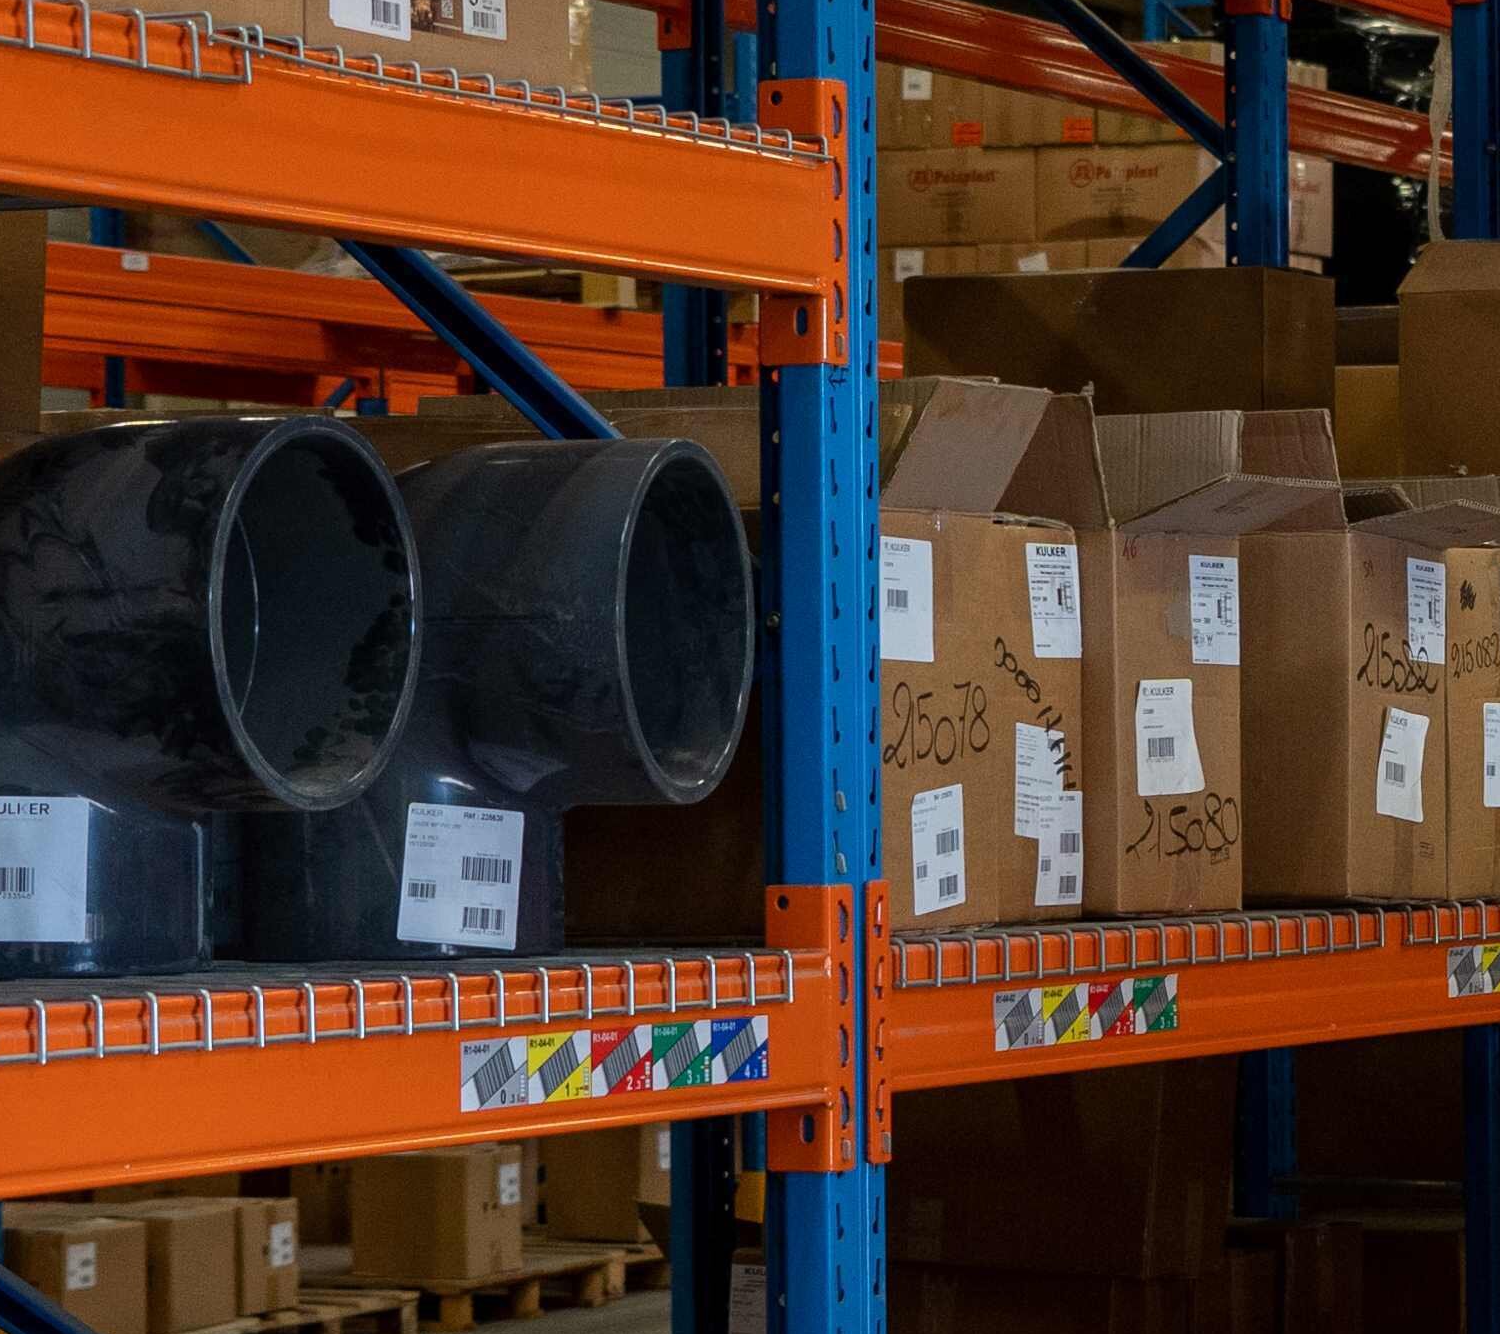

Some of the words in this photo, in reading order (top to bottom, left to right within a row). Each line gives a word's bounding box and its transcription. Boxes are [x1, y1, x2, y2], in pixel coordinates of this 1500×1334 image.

[1036, 546, 1067, 557] KULKER
[883, 681, 991, 769] 215078
[1125, 792, 1240, 861] 215080
[653, 1025, 678, 1036] R1-04-01
[712, 1022, 737, 1033] R1-04-01
[592, 1032, 618, 1043] R1-04-01
[529, 1038, 556, 1049] R1-04-01
[463, 1044, 491, 1056] R1-04-01
